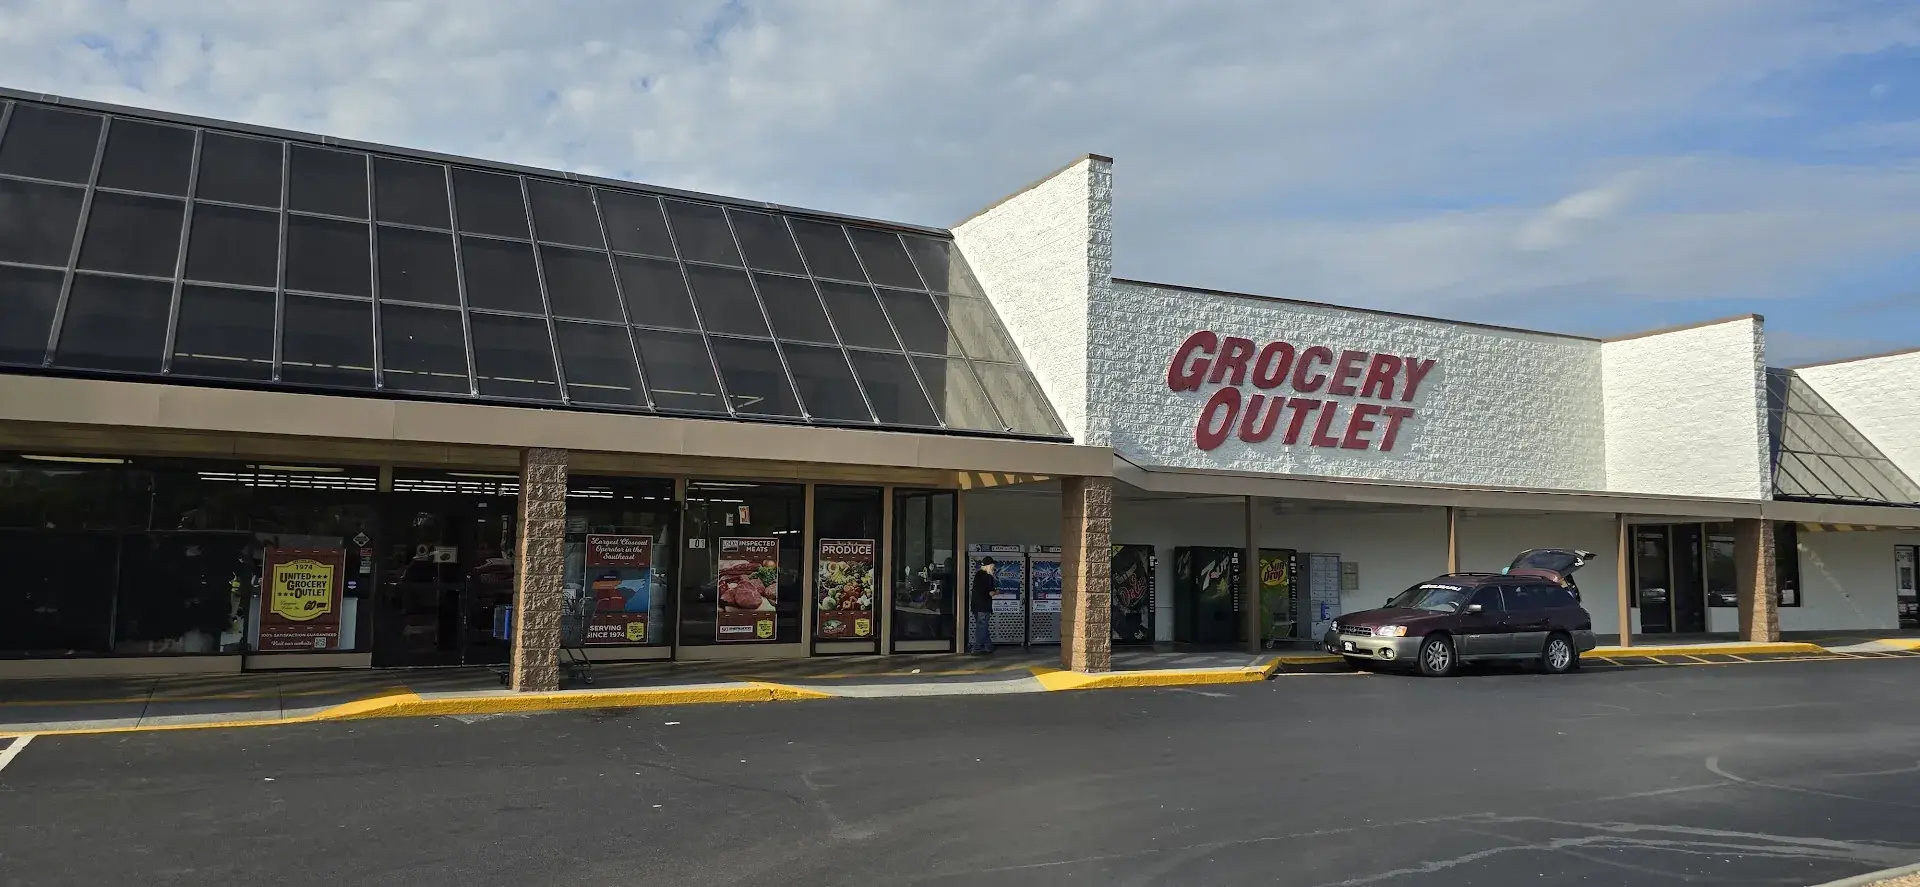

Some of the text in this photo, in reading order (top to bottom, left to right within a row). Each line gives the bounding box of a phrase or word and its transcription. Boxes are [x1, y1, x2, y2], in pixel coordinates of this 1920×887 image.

[1167, 331, 1436, 401] GROCERY
[1195, 387, 1414, 451] OUTLET
[591, 537, 618, 546] Largest
[595, 545, 625, 554] Operator
[632, 545, 642, 553] the
[822, 545, 872, 554] PRODUCE
[602, 552, 635, 560] Southeast
[279, 572, 311, 583] UNITED
[287, 580, 327, 591] GROCERY
[294, 588, 326, 598] OUTLET
